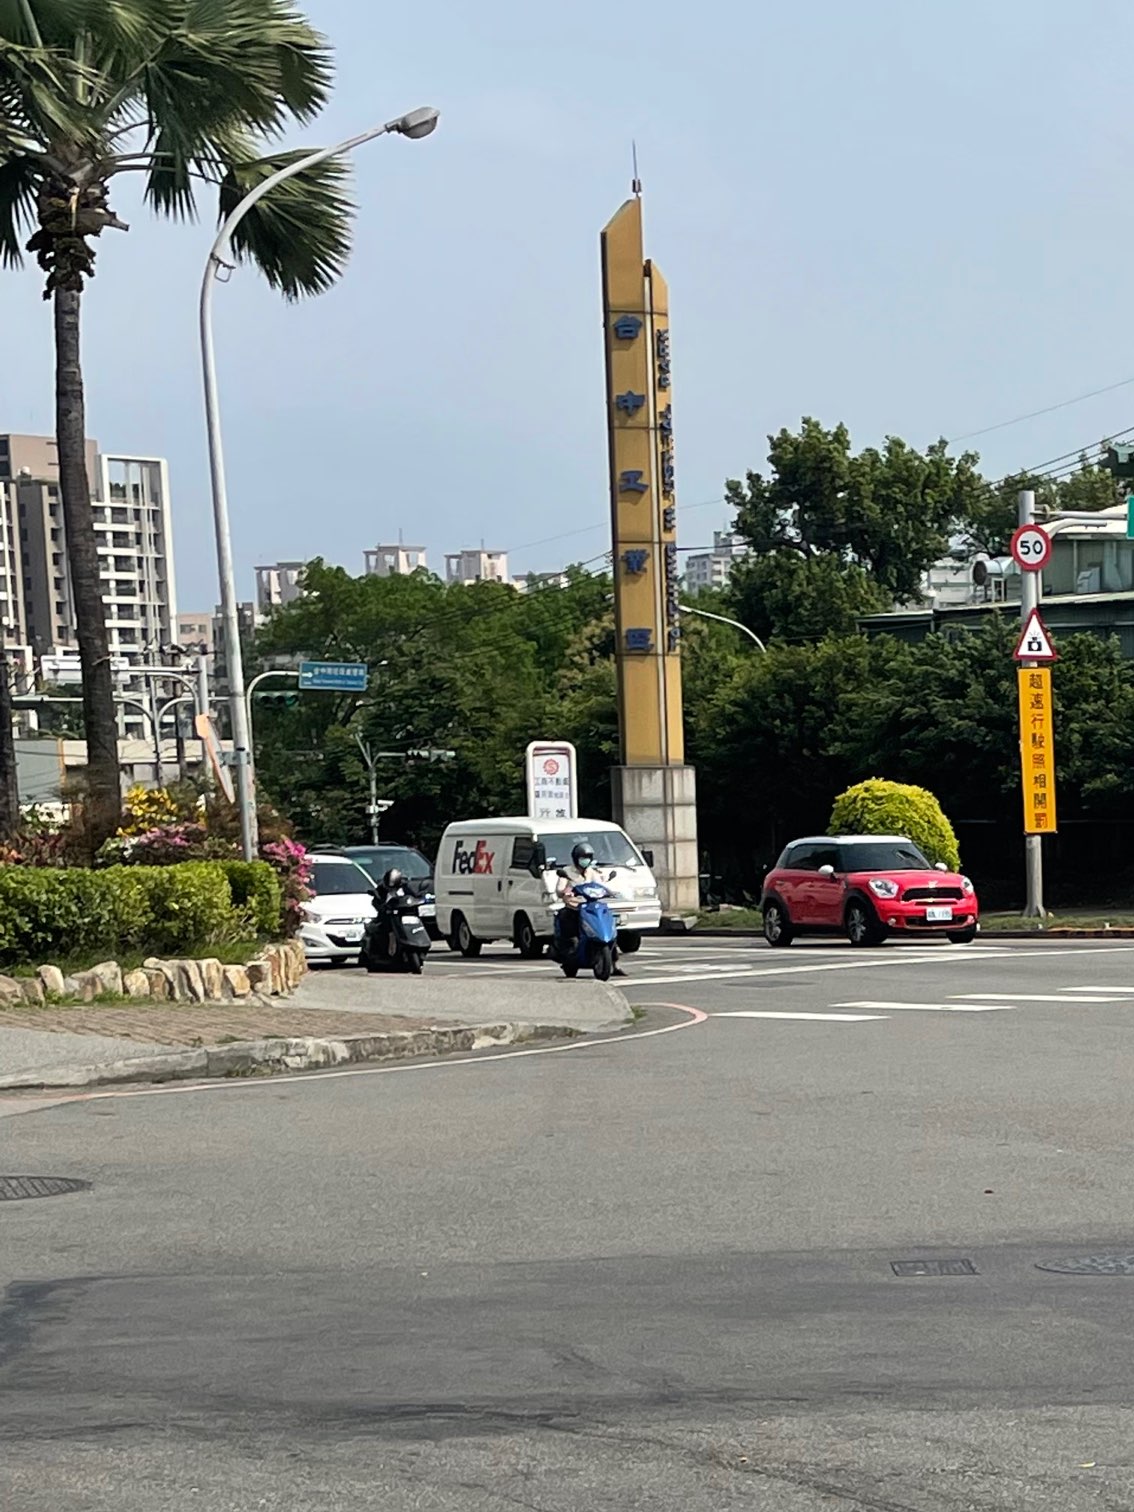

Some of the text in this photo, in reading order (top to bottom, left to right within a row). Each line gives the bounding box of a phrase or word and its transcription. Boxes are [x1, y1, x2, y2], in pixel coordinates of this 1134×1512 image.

[612, 315, 655, 650] 台中工業區
[1020, 540, 1043, 555] 50
[1028, 673, 1049, 829] 超速行駛照相開罰
[452, 840, 495, 874] FedEx
